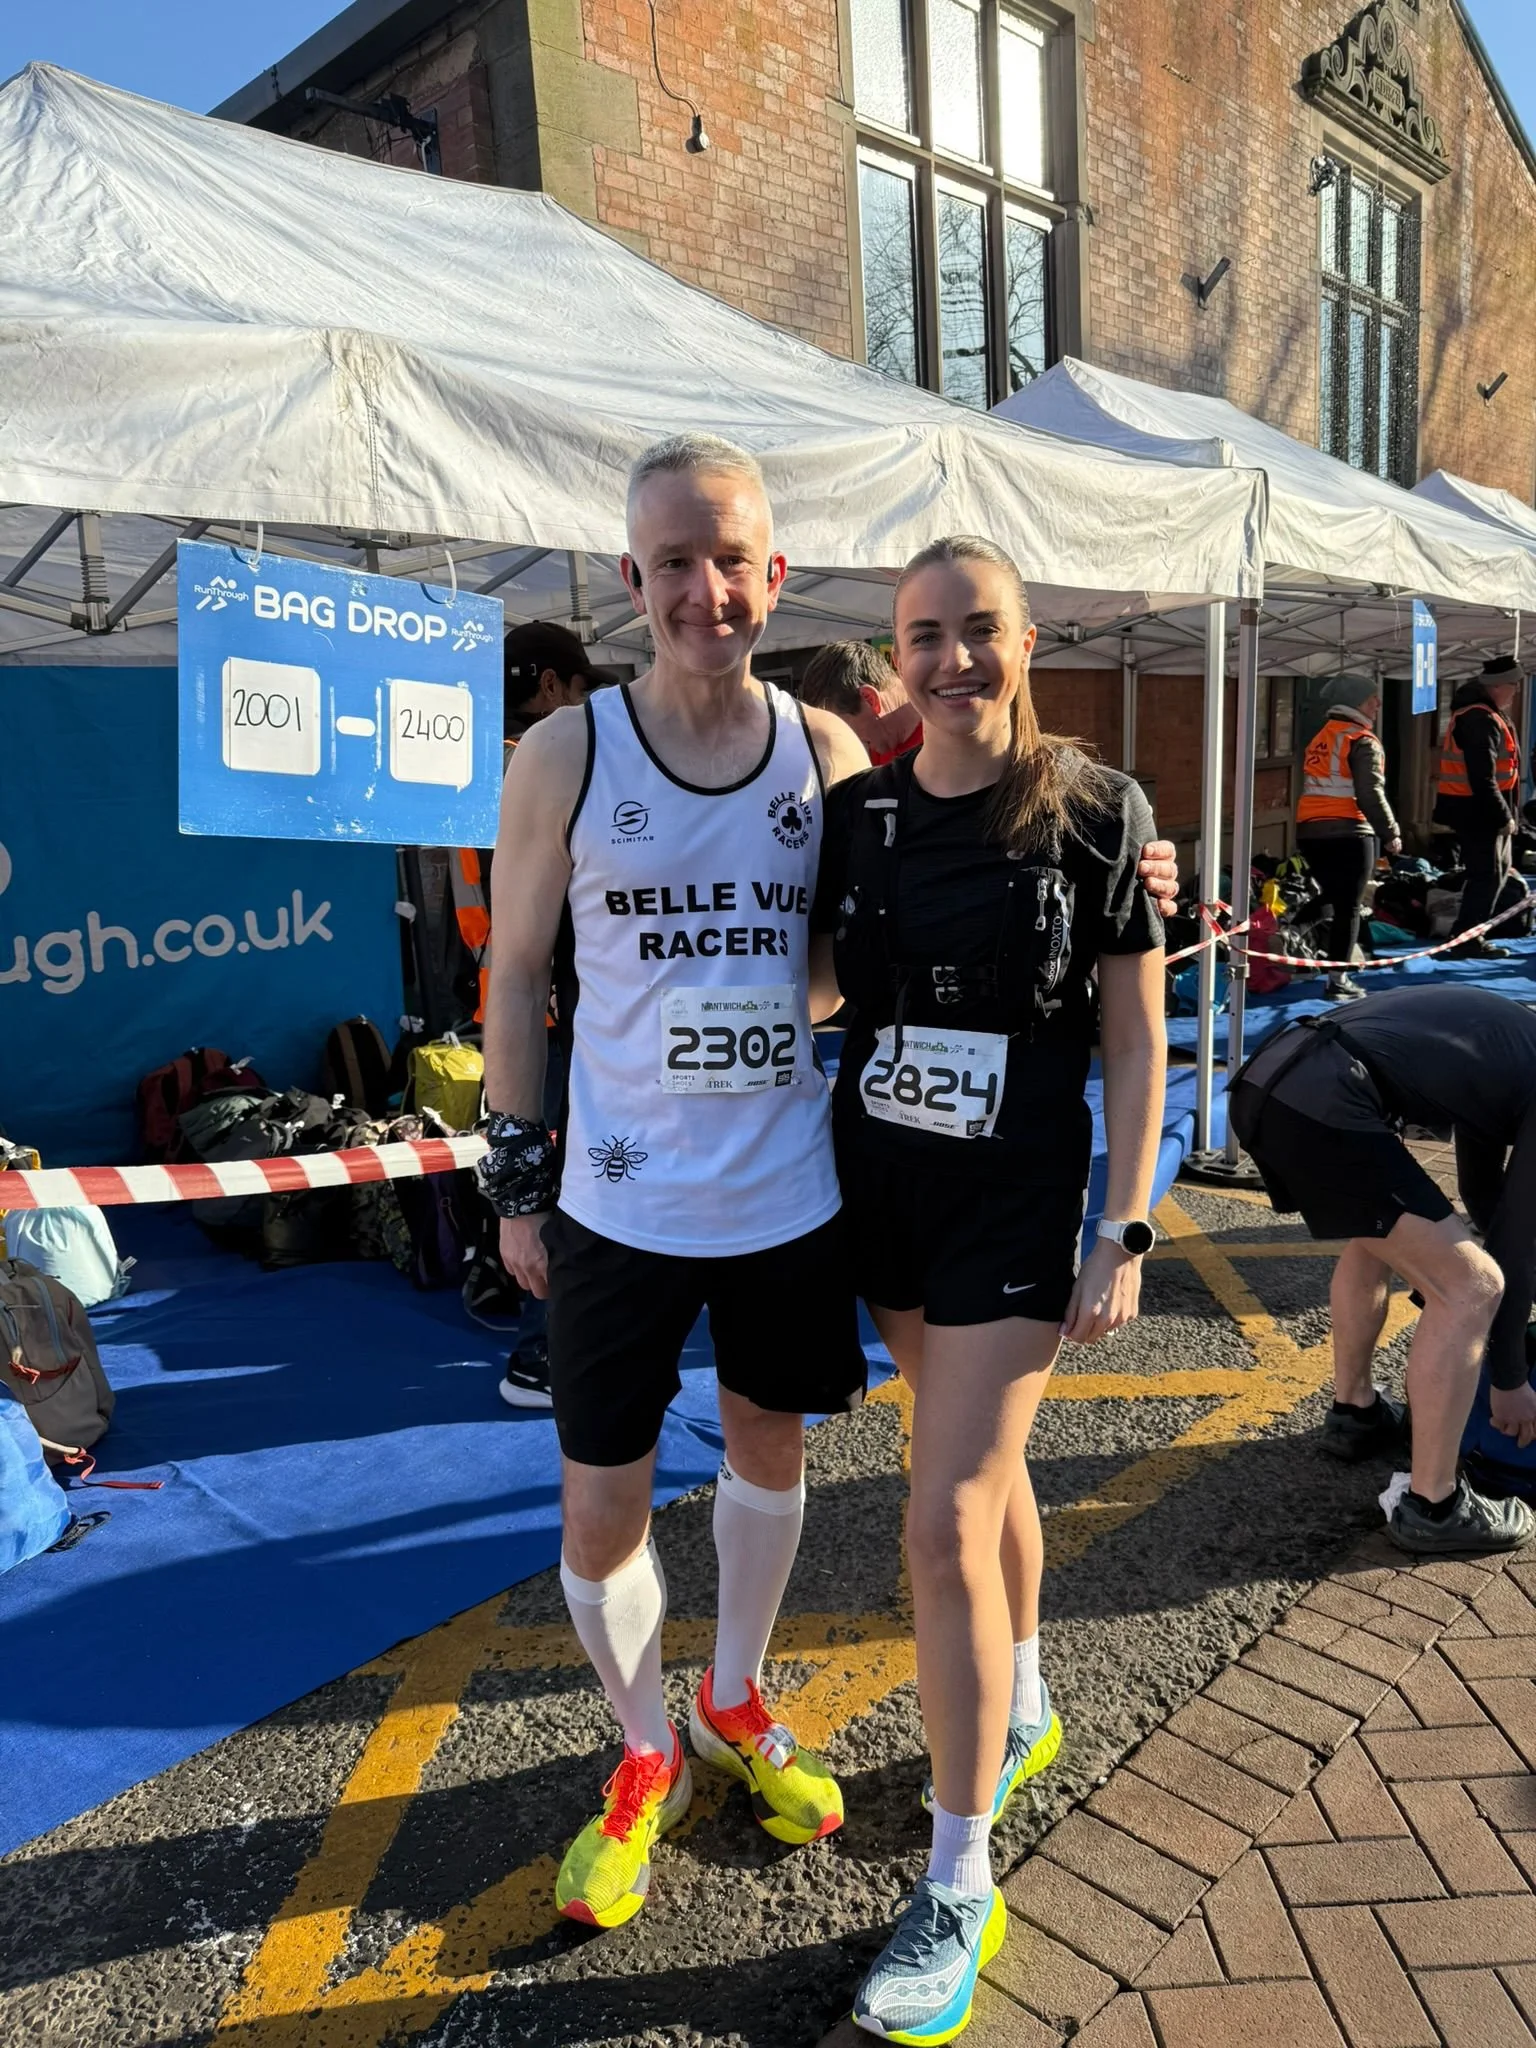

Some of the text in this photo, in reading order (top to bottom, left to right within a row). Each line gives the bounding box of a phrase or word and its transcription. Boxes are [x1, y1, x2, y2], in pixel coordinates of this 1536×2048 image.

[194, 585, 249, 601] RunThrough
[254, 585, 447, 644] BAG DROP
[232, 688, 302, 731] 2001
[400, 709, 465, 741] 2400
[767, 791, 796, 818] BELLE
[772, 827, 810, 849] RACERS
[605, 881, 808, 915] BELLE VUE
[639, 927, 789, 960] RACERS
[667, 1023, 796, 1071] 2302
[707, 1079, 734, 1089] TREK
[863, 1059, 998, 1116] 2824
